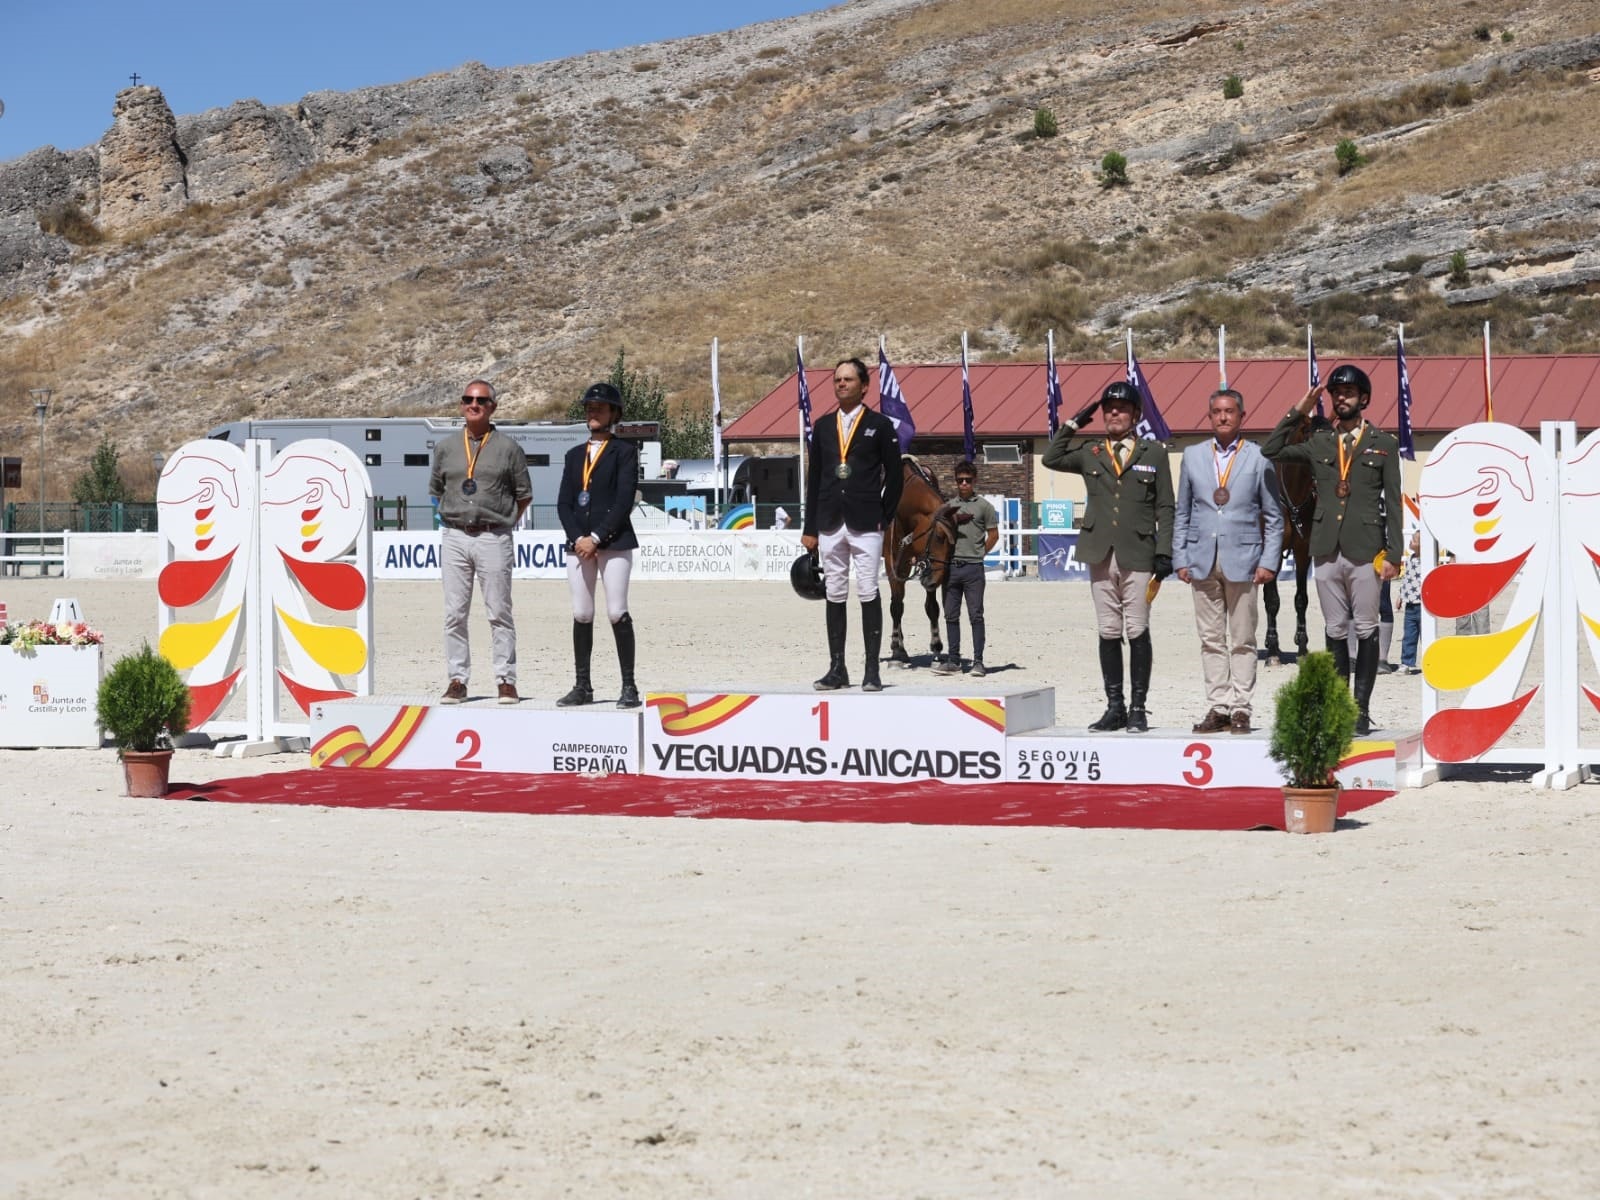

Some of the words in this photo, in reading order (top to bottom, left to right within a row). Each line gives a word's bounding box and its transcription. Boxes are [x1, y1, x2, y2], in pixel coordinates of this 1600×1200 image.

[385, 543, 441, 568] ANCA
[641, 545, 666, 557] REAL
[668, 541, 733, 557] FEDERACIÓN
[766, 545, 793, 557] REAL
[641, 558, 674, 573] HÍPICA
[677, 558, 731, 573] ESPAÑOLA
[28, 705, 58, 713] Castilla
[59, 706, 65, 714] y
[811, 701, 829, 741] 1
[455, 729, 482, 769] 2
[552, 742, 628, 755] CAMPEONATO
[1018, 750, 1100, 762] SEGOVIA
[553, 755, 628, 774] ESPAÑA
[1018, 762, 1101, 781] 2025
[1182, 742, 1214, 786] 3
